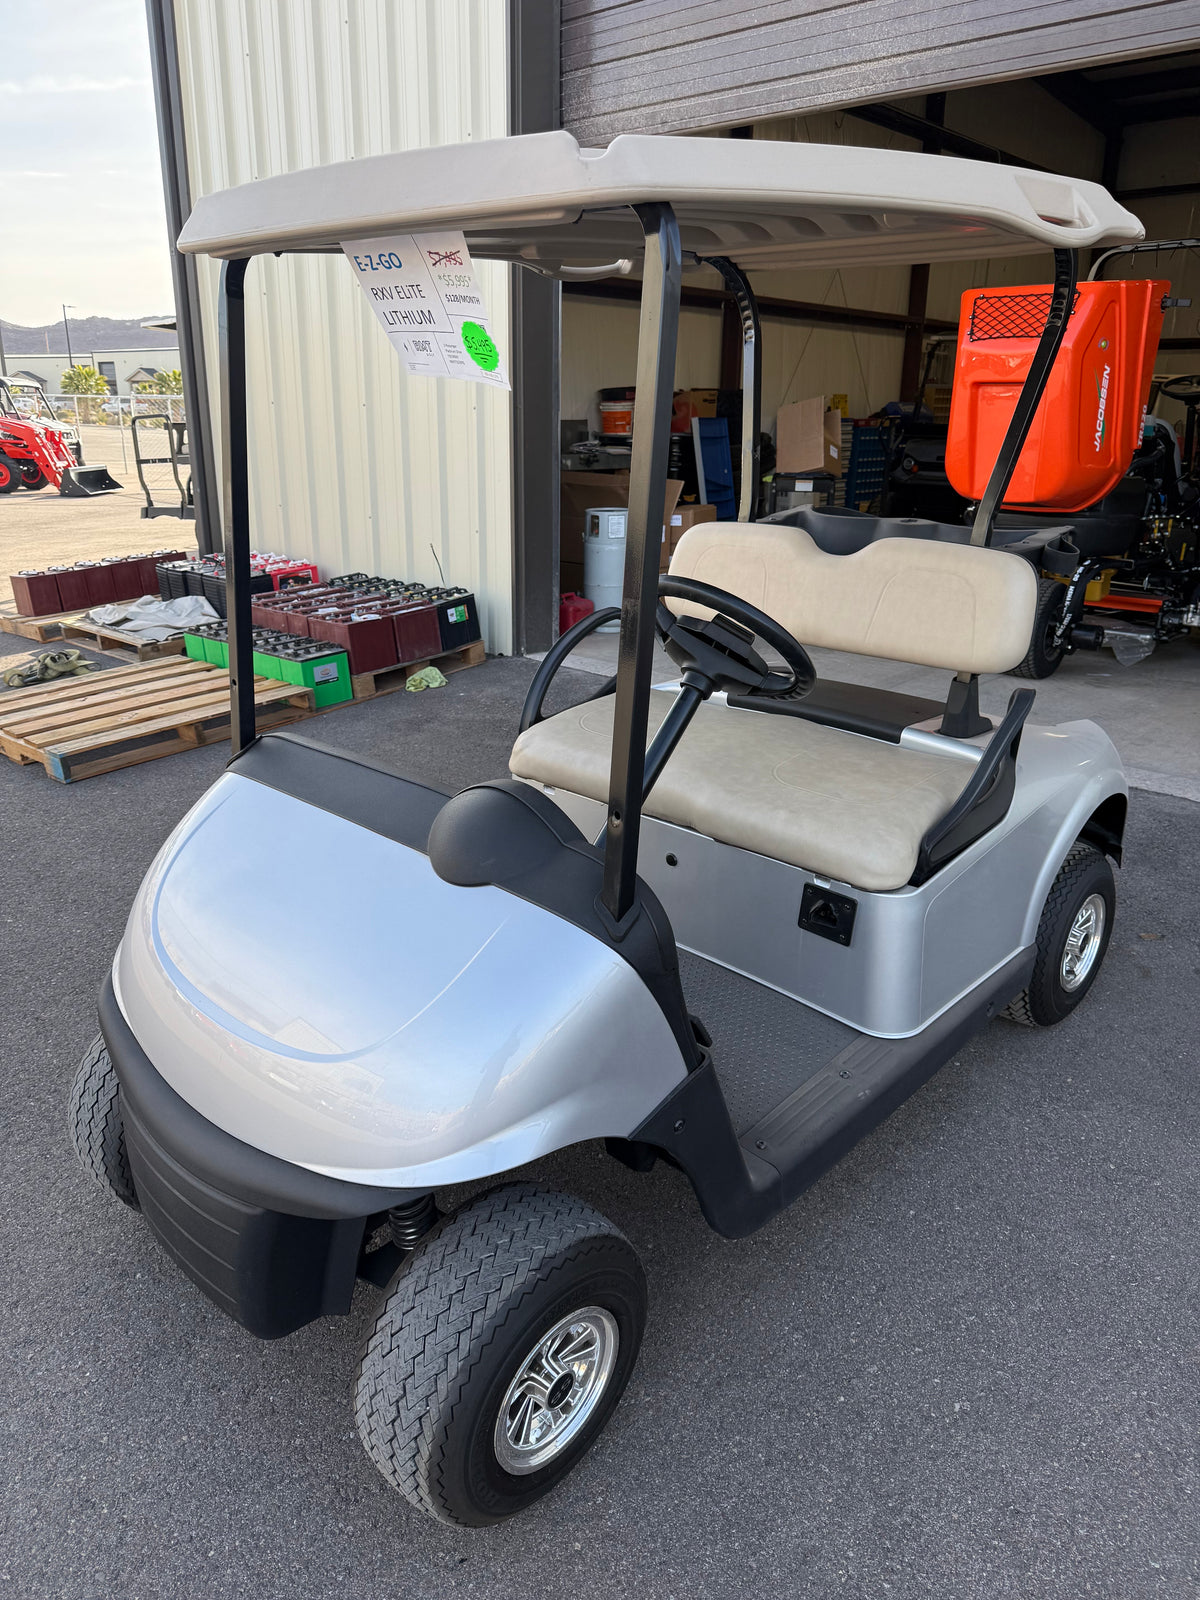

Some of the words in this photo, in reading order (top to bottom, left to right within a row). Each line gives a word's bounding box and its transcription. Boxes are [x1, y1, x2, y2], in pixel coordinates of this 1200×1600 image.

[353, 252, 403, 272] E-Z-GO
[370, 286, 394, 301] RXV
[382, 309, 436, 326] LITHIUM
[1089, 363, 1111, 452] JACOBSEN
